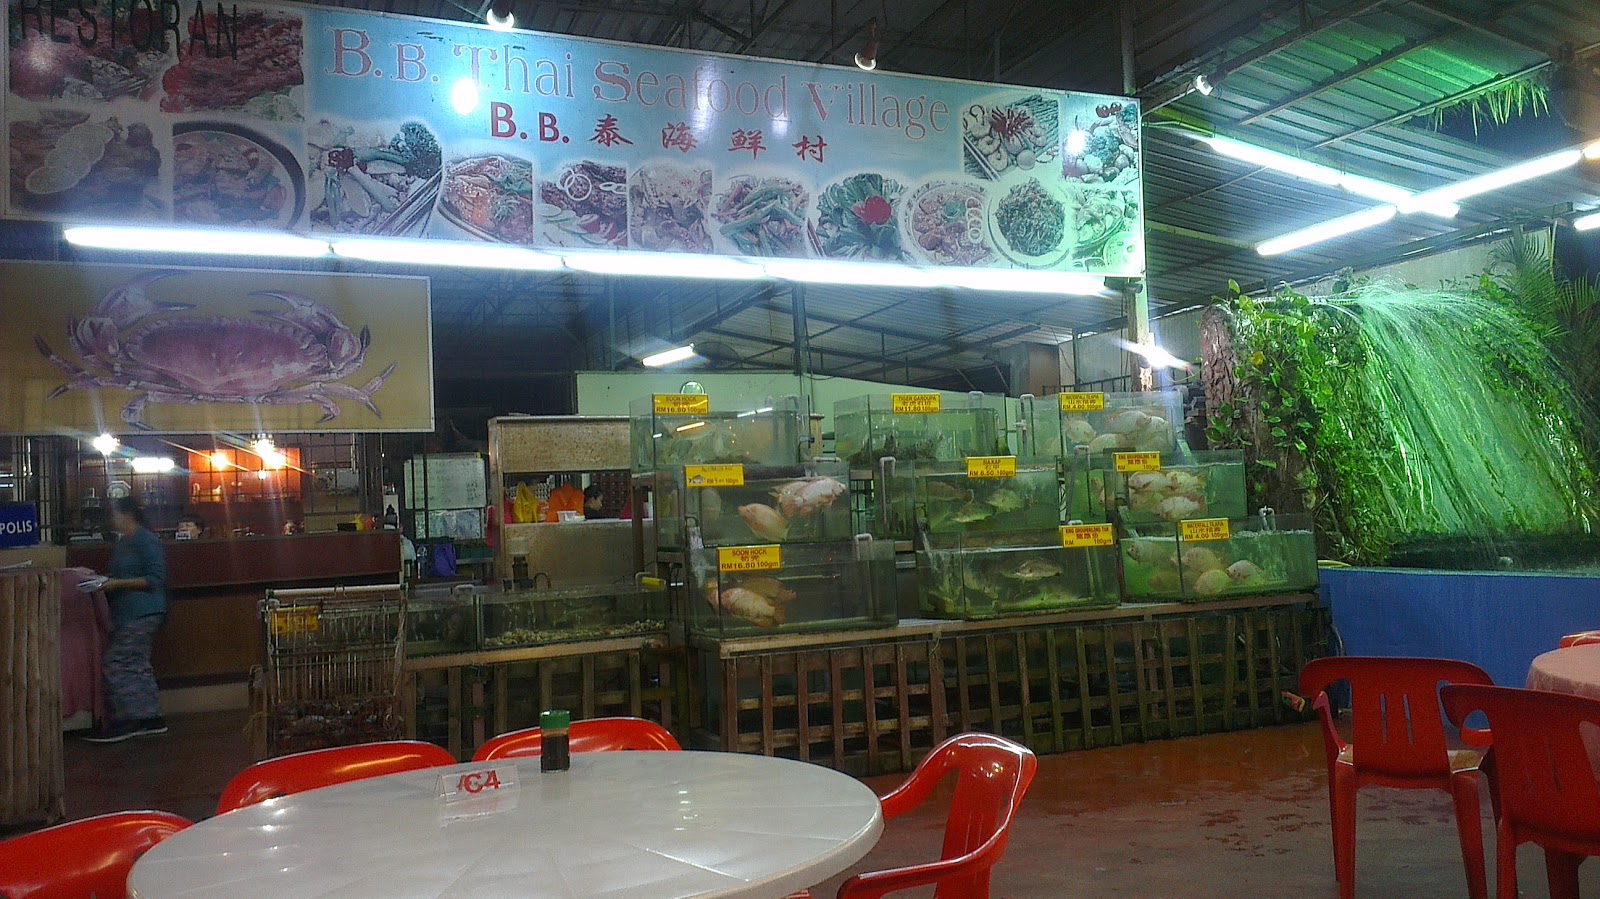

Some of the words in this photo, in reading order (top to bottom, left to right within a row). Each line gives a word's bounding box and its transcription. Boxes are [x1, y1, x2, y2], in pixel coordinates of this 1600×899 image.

[453, 44, 574, 98] Thai
[593, 60, 789, 119] Seafood
[802, 82, 949, 141] Village
[0, 520, 33, 535] POLIS
